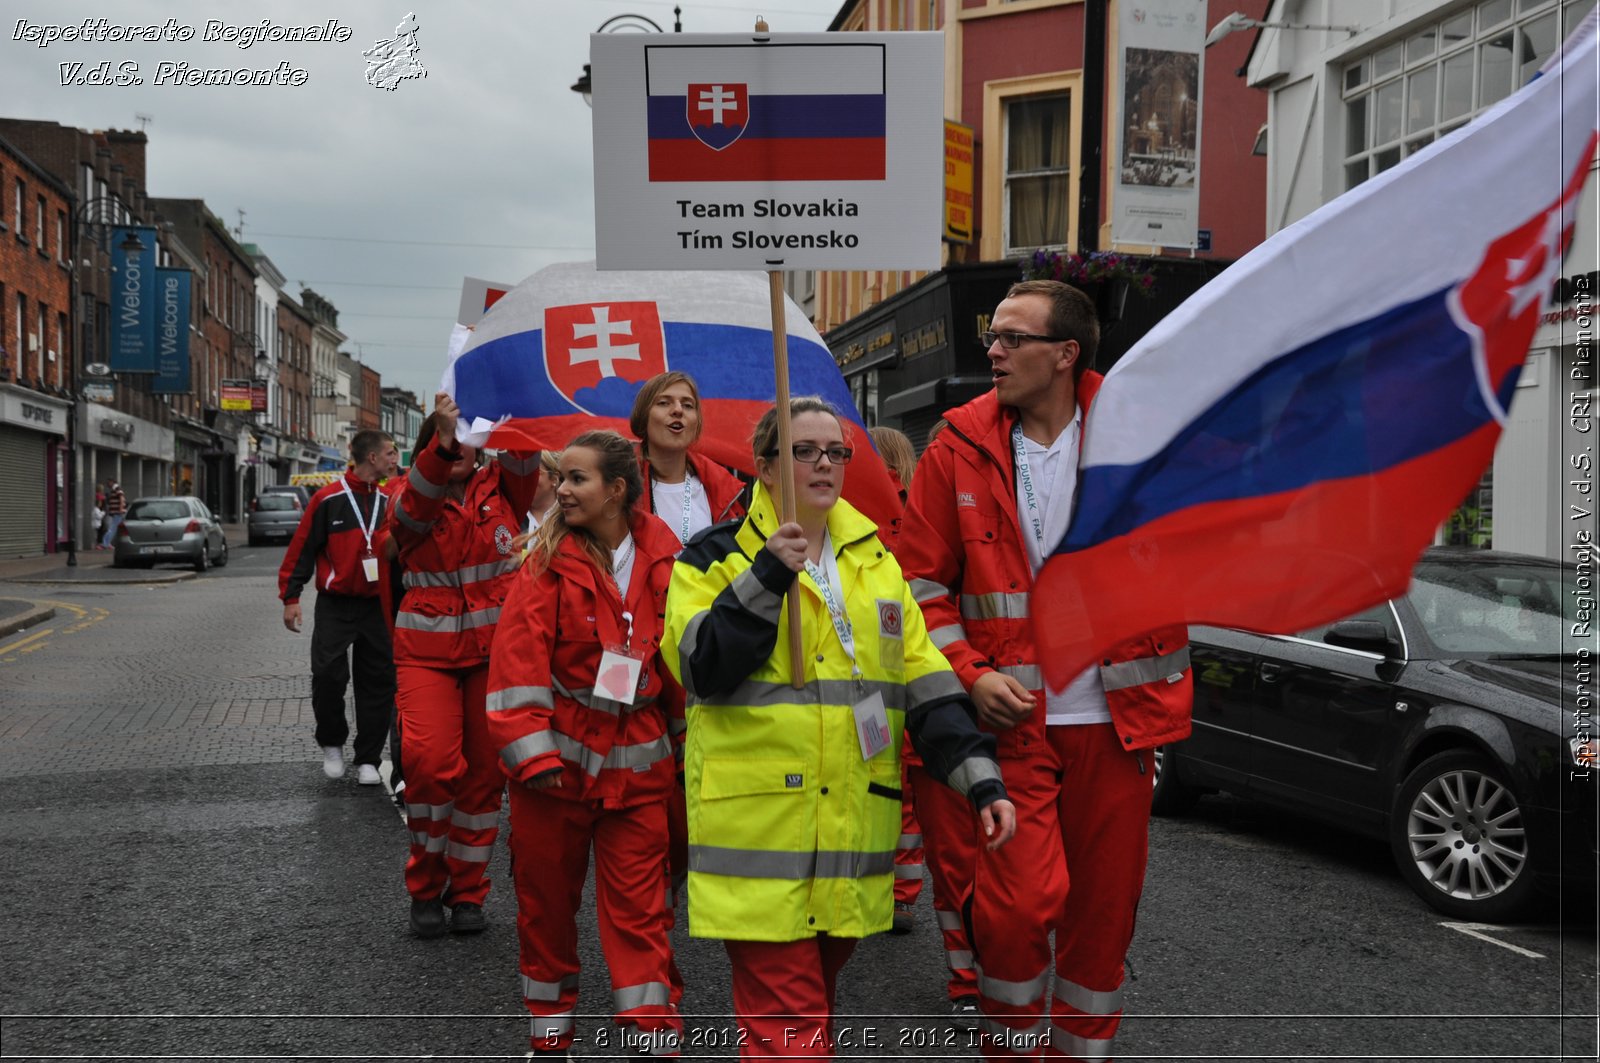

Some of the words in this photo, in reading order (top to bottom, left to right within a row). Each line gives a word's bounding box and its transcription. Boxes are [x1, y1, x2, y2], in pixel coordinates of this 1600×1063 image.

[676, 199, 745, 218] Team
[753, 198, 859, 218] Slovakia
[677, 229, 723, 249] Tím
[732, 229, 860, 249] Slovensko
[160, 277, 179, 356] Welcome
[1015, 436, 1026, 457] 2012
[1020, 463, 1037, 510] DUNDALK
[683, 495, 691, 512] 2012
